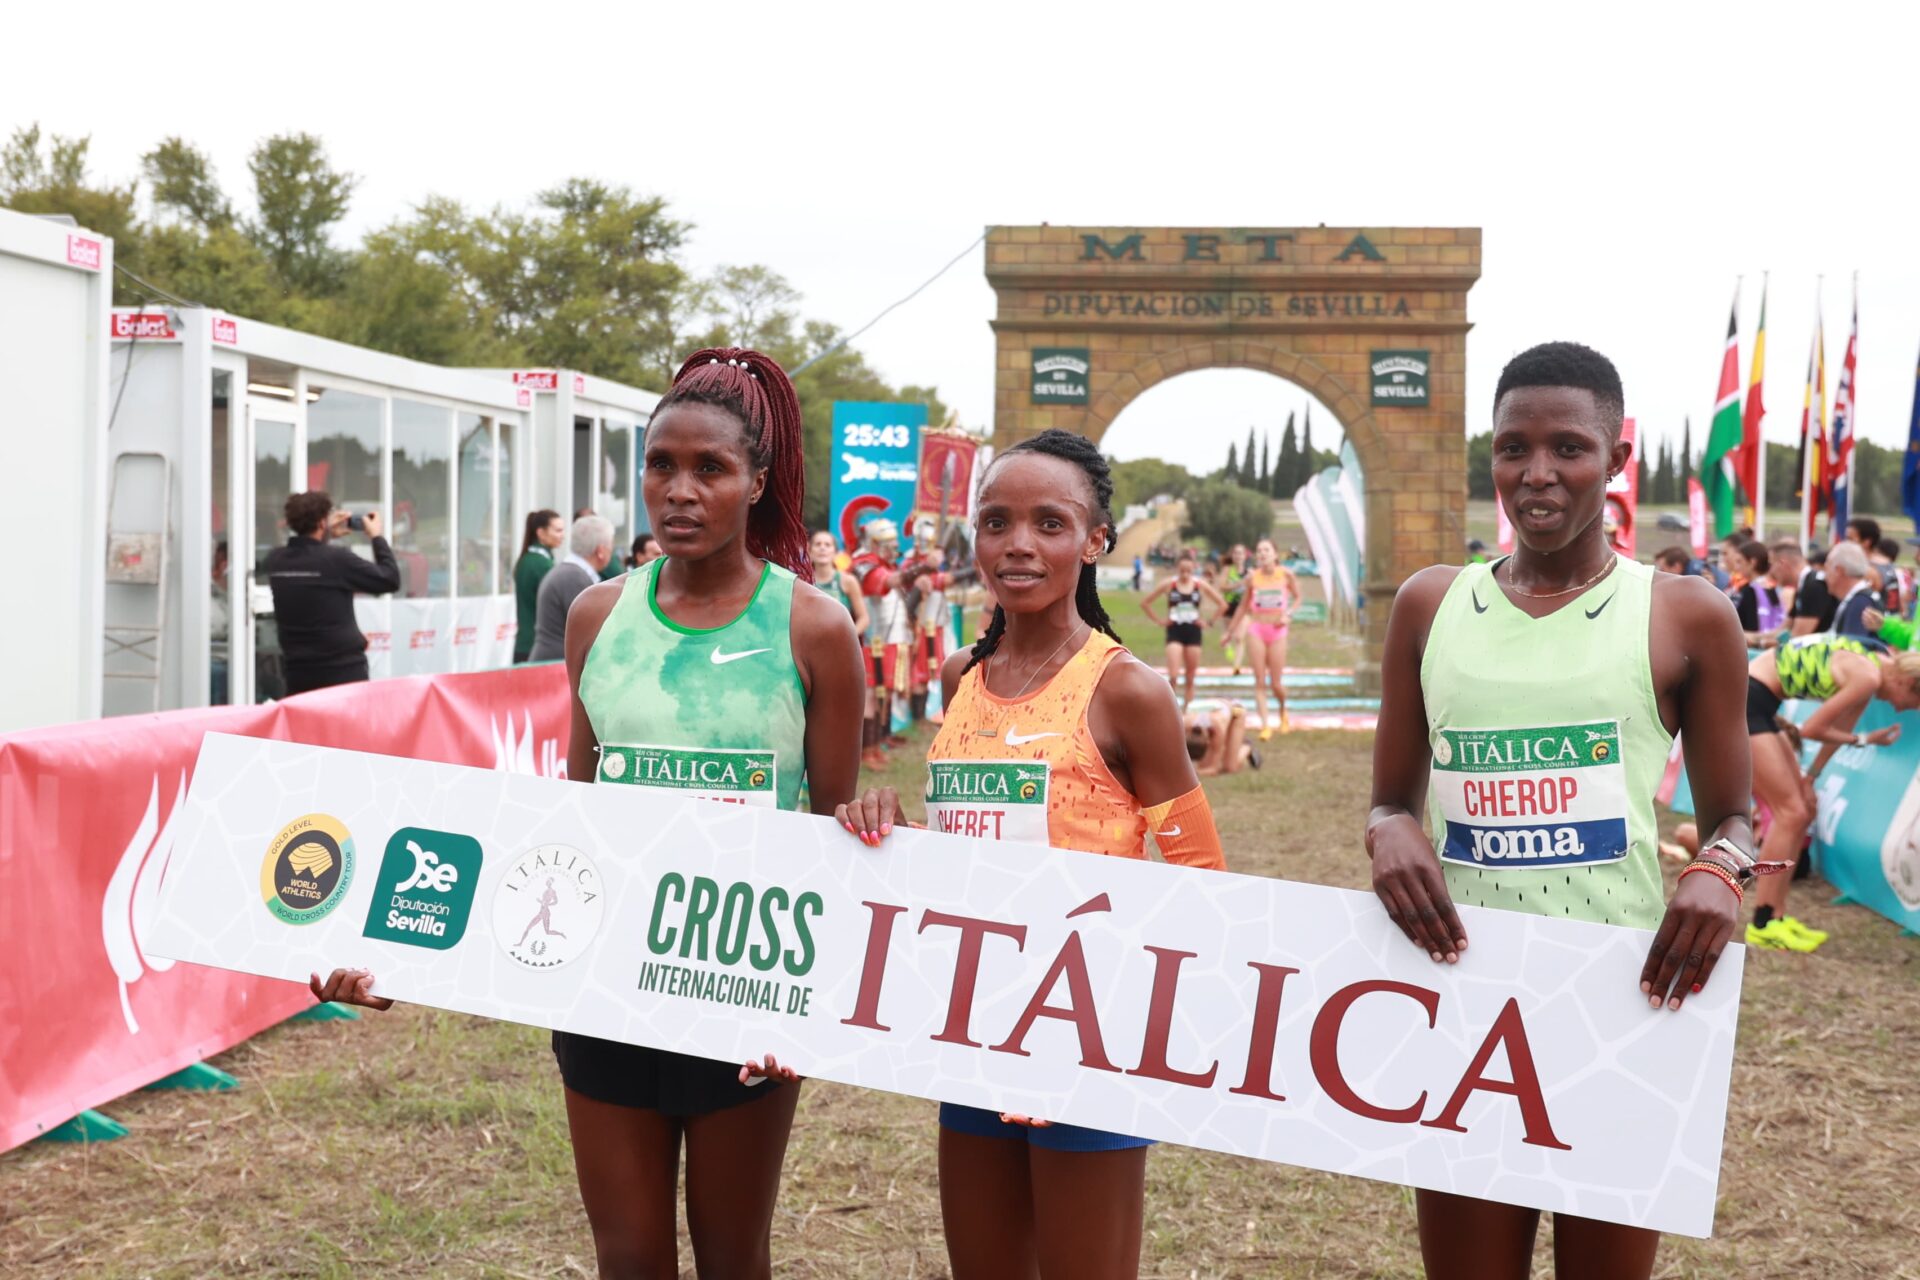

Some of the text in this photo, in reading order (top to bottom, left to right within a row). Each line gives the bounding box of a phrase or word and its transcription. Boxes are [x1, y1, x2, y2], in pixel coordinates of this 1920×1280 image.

[1078, 234, 1387, 262] META
[1237, 296, 1273, 317] DE
[1288, 295, 1411, 317] SEVILLA
[1034, 383, 1086, 396] SEVILLA
[1374, 386, 1426, 398] SEVILLA
[843, 423, 910, 448] 25:43
[1458, 735, 1580, 765] ITÁLICA
[633, 754, 739, 784] ITÁLICA
[936, 767, 1010, 795] ITÁLICA
[1463, 776, 1578, 817] CHEROP
[271, 819, 313, 855] GOLD LEVEL
[276, 851, 353, 921] WORLD CROSS COUNTRY TOUR
[290, 879, 318, 890] WORLD
[505, 849, 597, 904] ITÁLICA
[281, 886, 322, 899] ATHLETICS
[391, 895, 450, 916] Diputación
[386, 909, 446, 937] Sevilla
[647, 872, 824, 977] CROSS
[637, 961, 813, 1017] INTERNACIONAL DE
[840, 892, 1573, 1151] ITÁLICA
